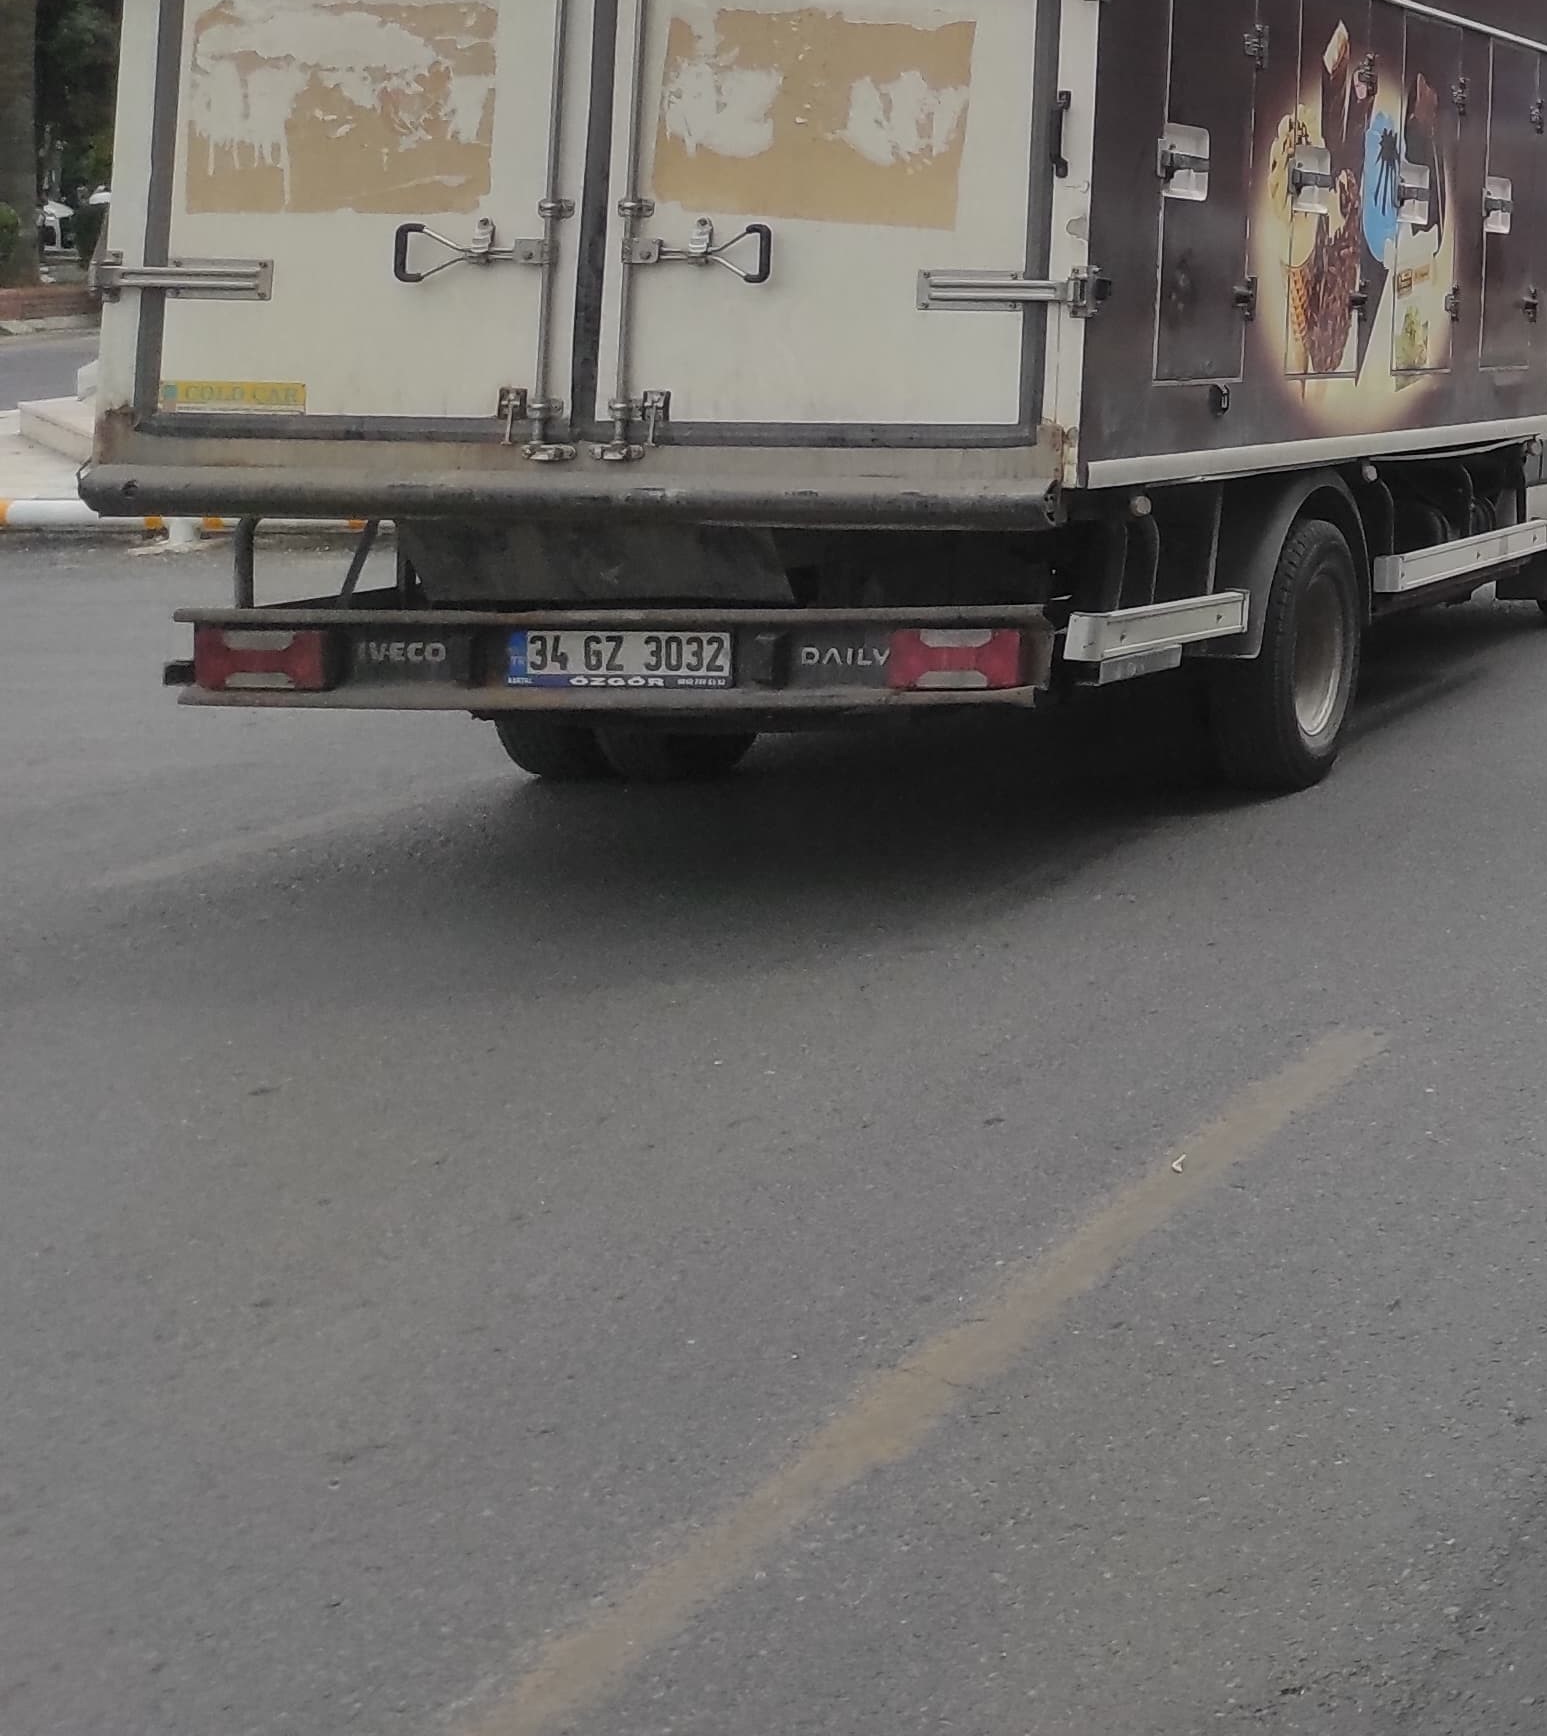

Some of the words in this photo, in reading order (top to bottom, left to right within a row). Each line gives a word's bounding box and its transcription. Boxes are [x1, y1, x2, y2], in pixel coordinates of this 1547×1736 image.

[357, 641, 447, 662] IVECO
[530, 635, 569, 671] 34
[584, 635, 624, 672] GZ
[644, 636, 724, 673] 3032
